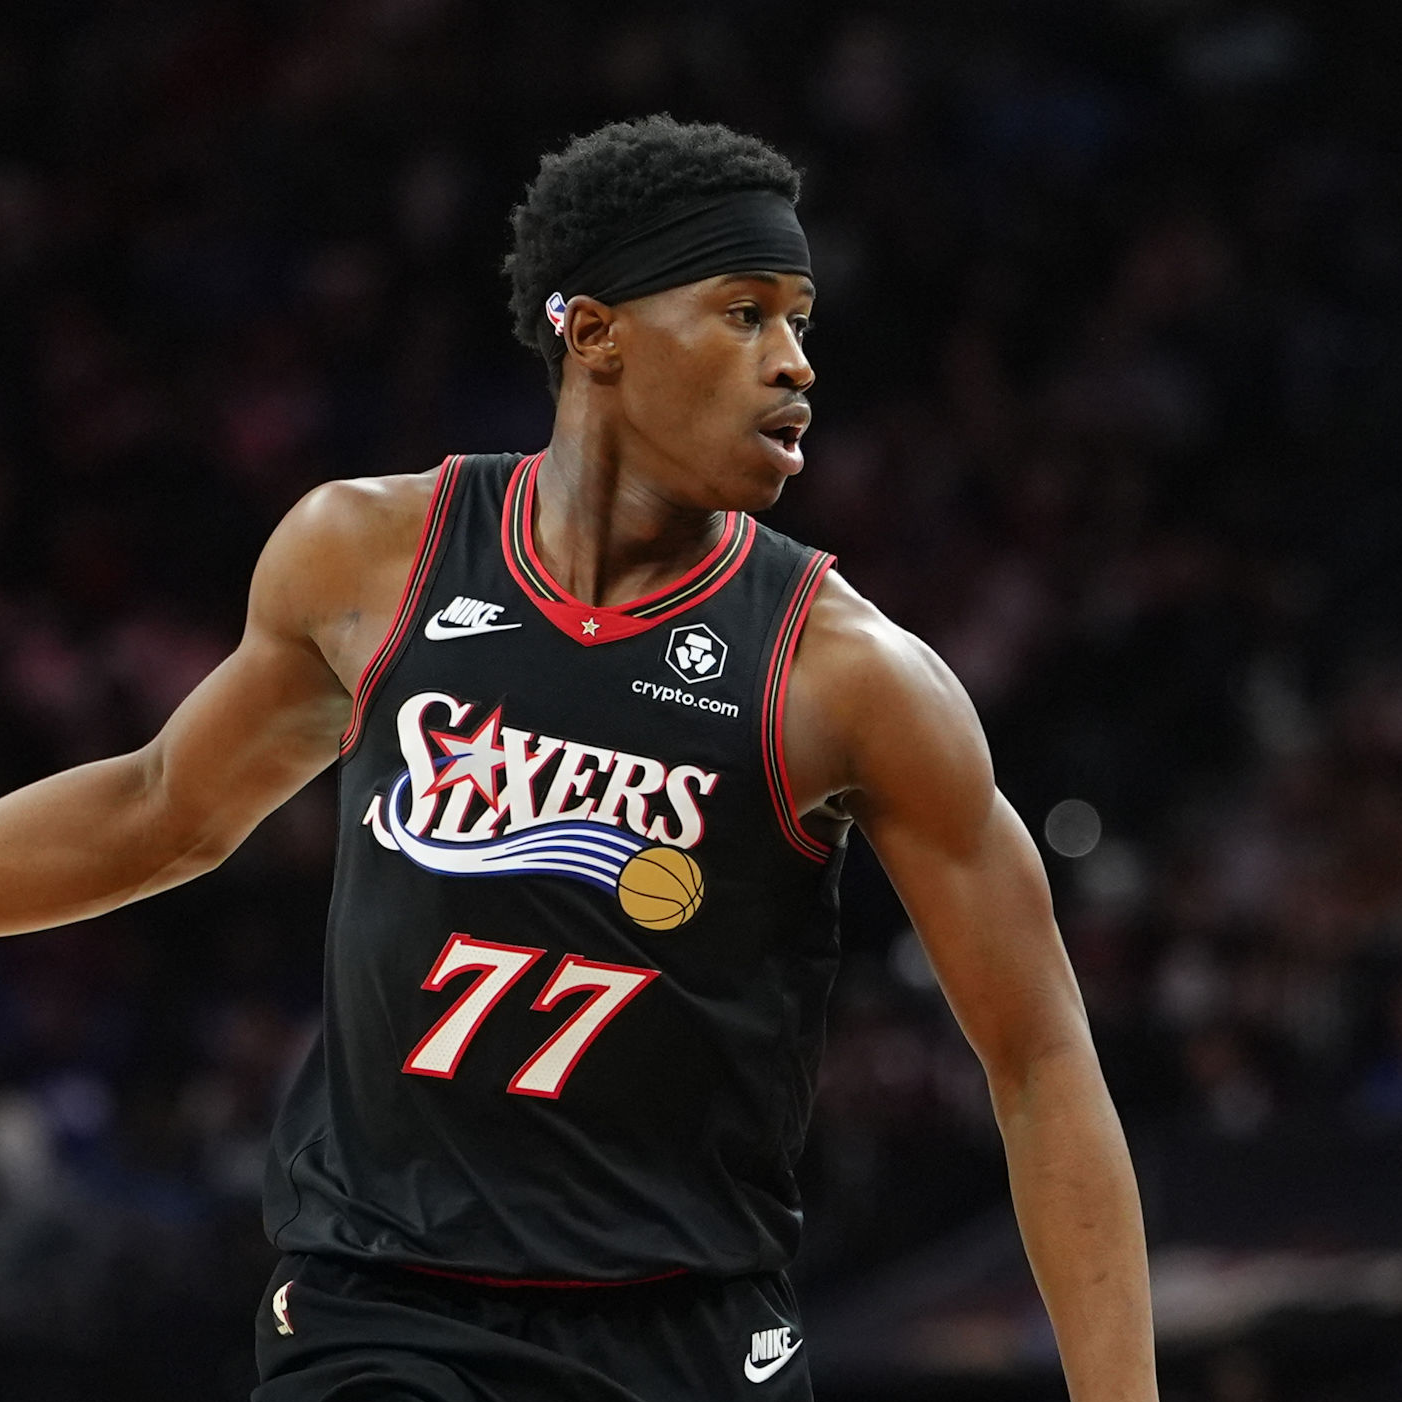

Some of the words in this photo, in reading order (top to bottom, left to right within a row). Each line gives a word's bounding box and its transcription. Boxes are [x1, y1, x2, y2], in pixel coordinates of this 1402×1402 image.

[439, 596, 505, 627] NIKE
[631, 680, 739, 718] crypto.com
[362, 691, 720, 851] SIXERS
[401, 933, 662, 1100] 77
[751, 1327, 791, 1363] NIKE
